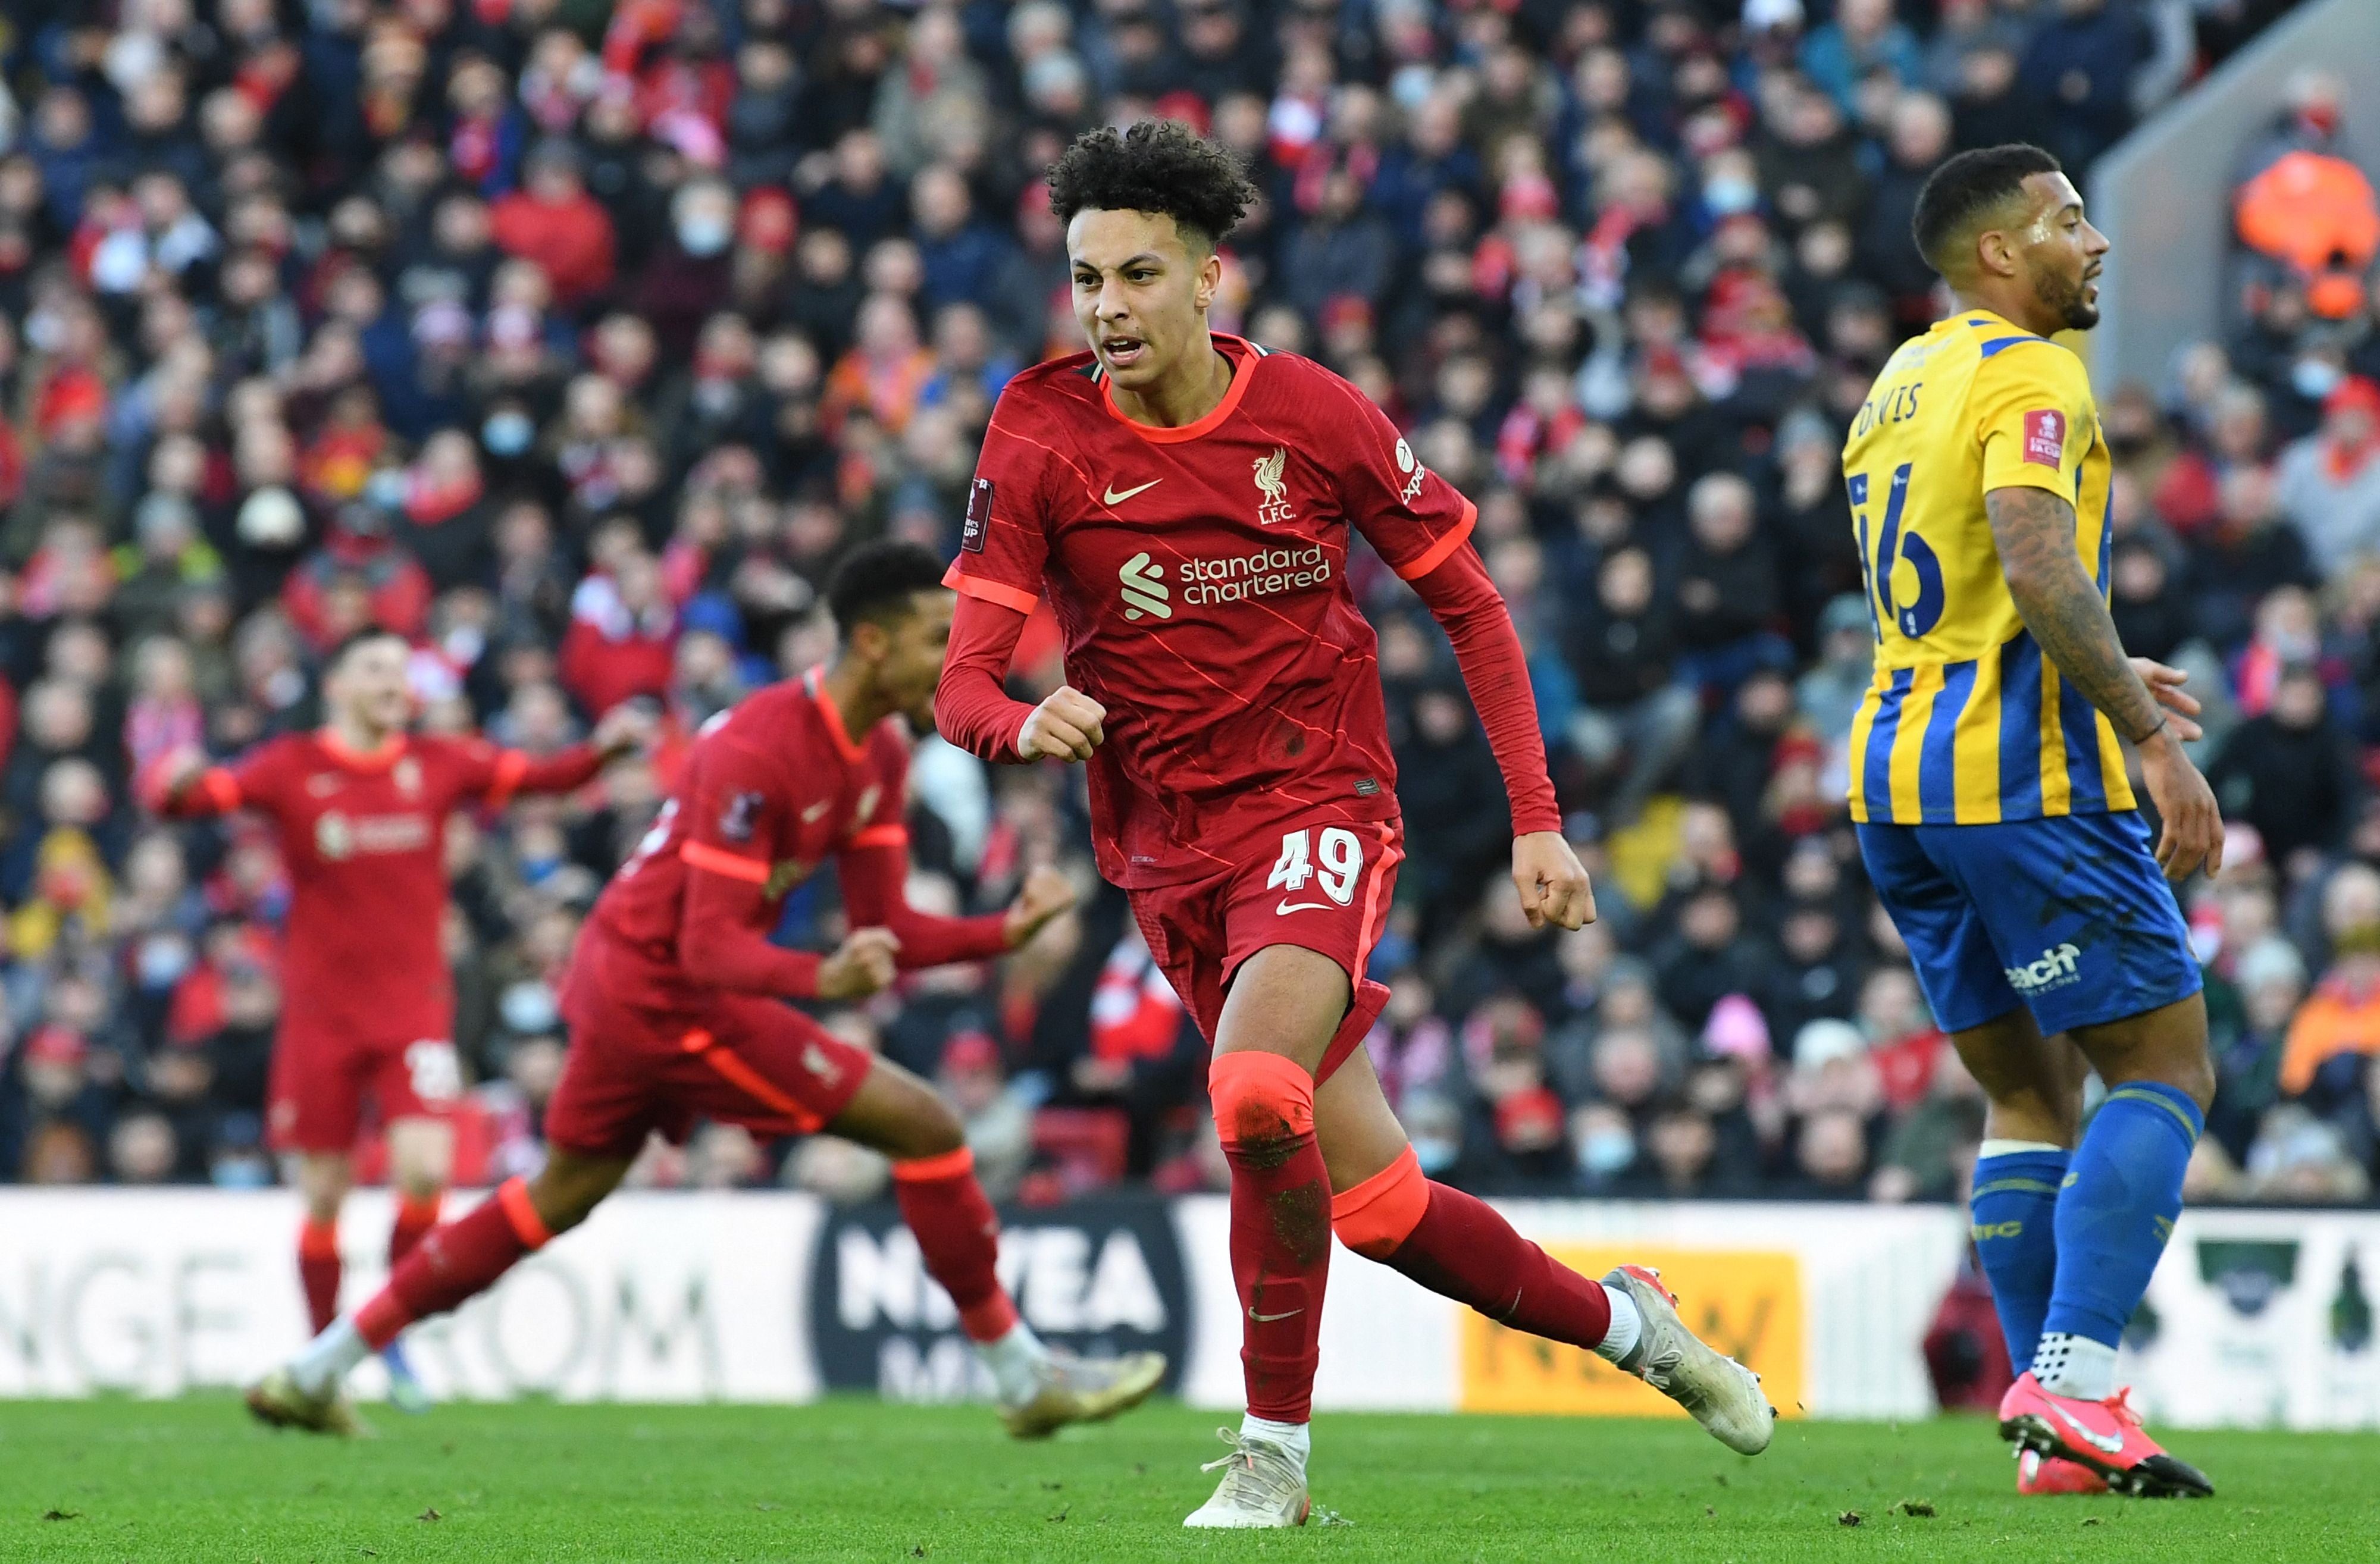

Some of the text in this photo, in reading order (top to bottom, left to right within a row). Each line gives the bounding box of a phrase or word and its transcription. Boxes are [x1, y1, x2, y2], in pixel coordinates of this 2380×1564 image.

[1858, 383, 1922, 437] DVIS
[1258, 503, 1297, 525] L.F.C.
[1179, 544, 1322, 583] standard
[1183, 559, 1331, 605] chartered
[1266, 827, 1364, 907] 49
